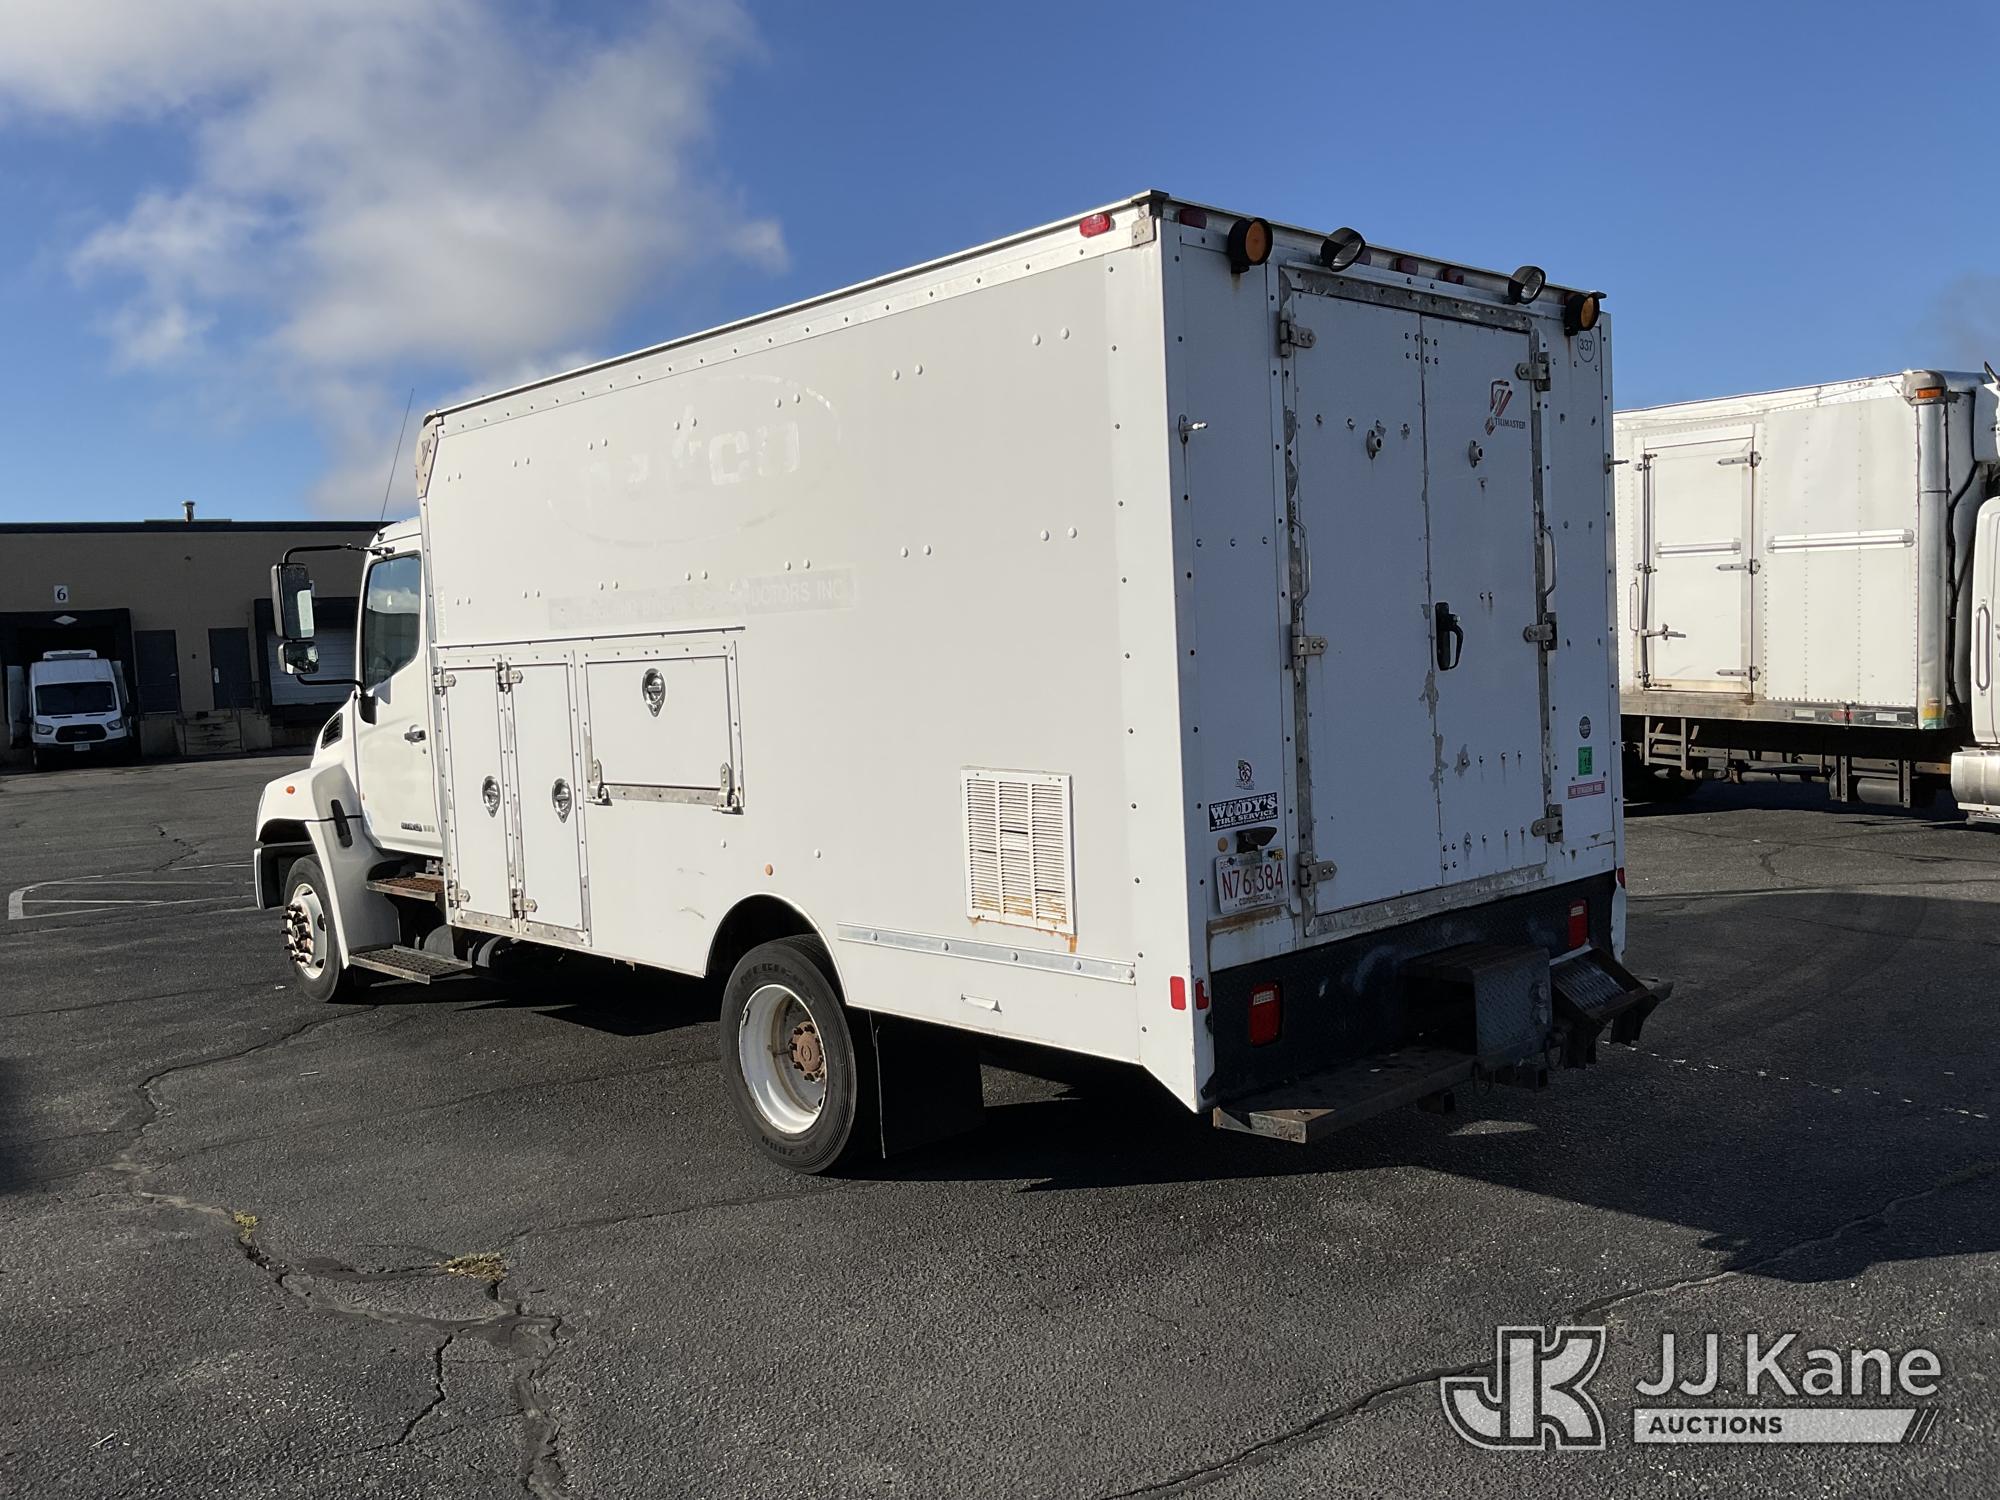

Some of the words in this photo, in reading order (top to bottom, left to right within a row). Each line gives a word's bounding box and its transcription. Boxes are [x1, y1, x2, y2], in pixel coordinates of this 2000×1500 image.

[1579, 338, 1593, 352] 337
[57, 587, 66, 601] 6
[1210, 796, 1277, 820] WOODY'S
[1215, 815, 1236, 826] TIRE
[1238, 809, 1274, 821] SERVICE
